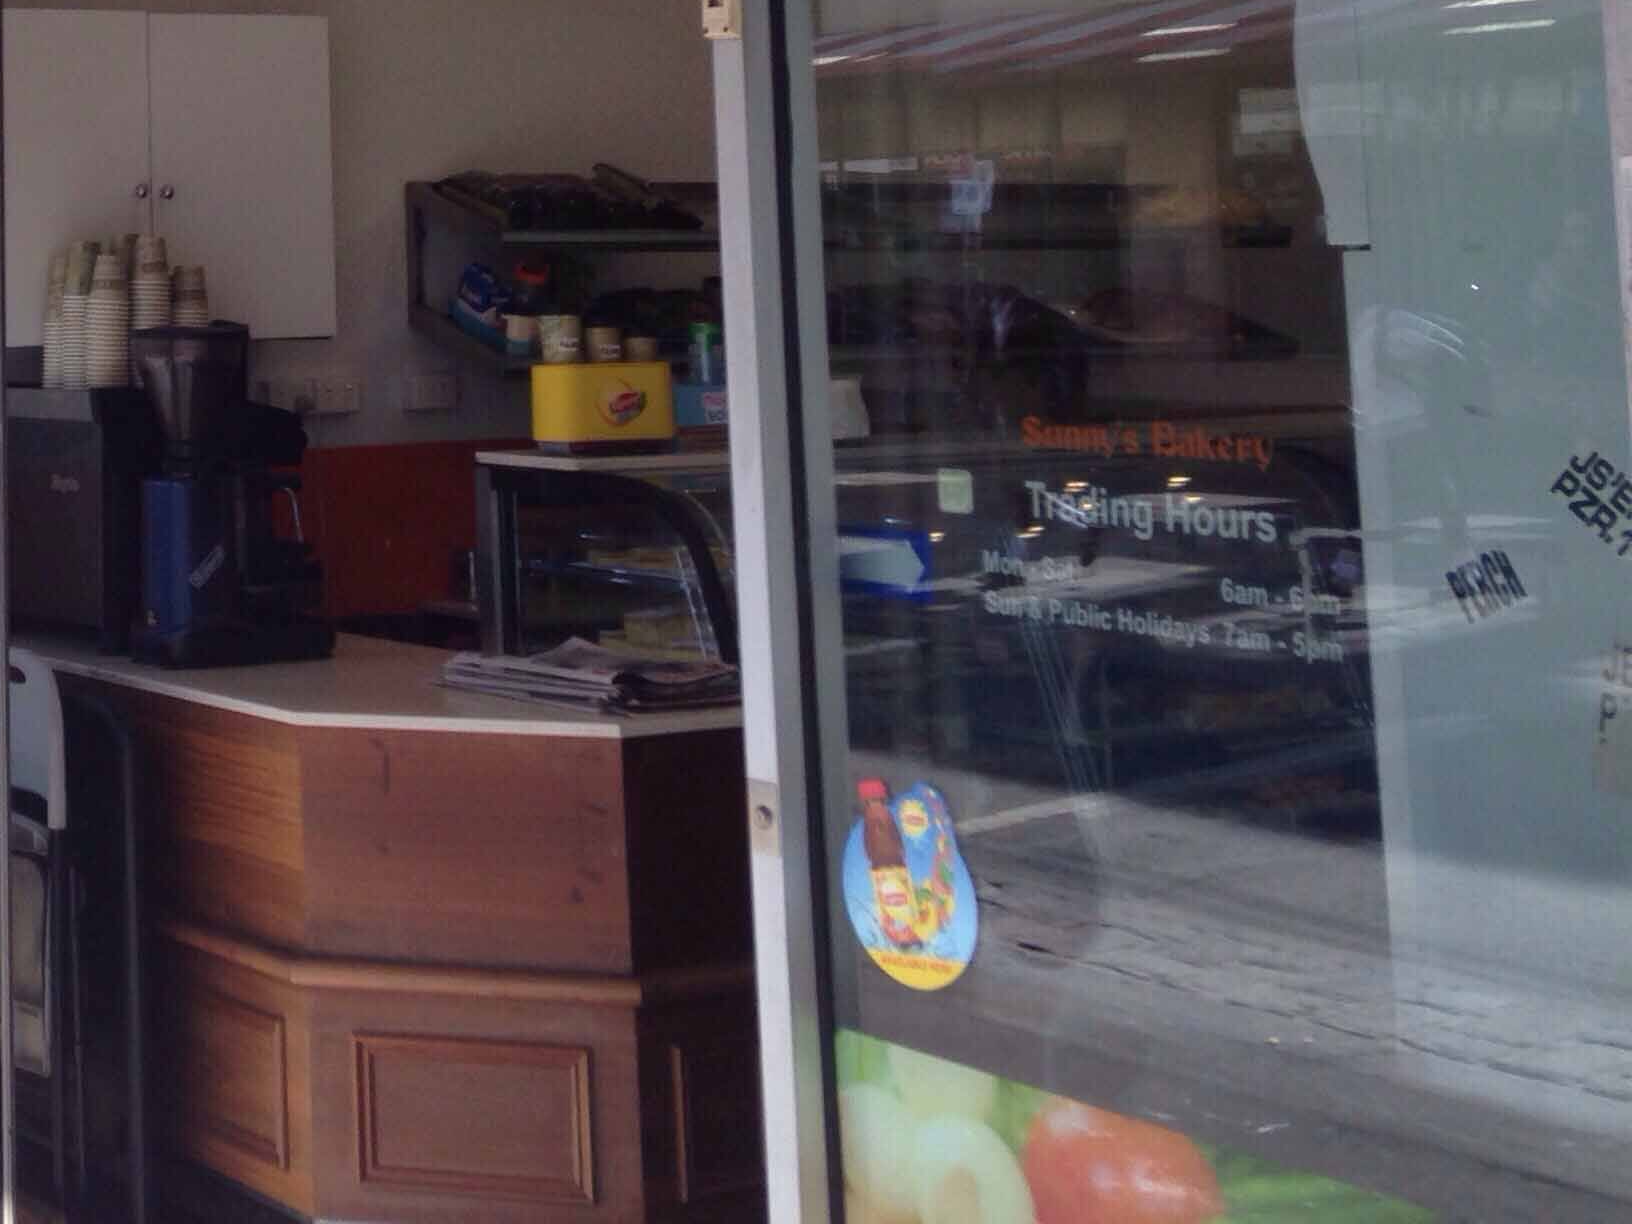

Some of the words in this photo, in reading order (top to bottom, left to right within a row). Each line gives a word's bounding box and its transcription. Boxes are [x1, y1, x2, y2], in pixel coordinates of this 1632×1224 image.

[1022, 416, 1141, 457] Sunny's
[1151, 421, 1272, 471] Bakery
[1025, 480, 1154, 540] Trading
[1168, 492, 1277, 543] Hours
[1221, 577, 1267, 606] 6am
[1049, 600, 1112, 632] Public
[1119, 607, 1211, 648] Holidays
